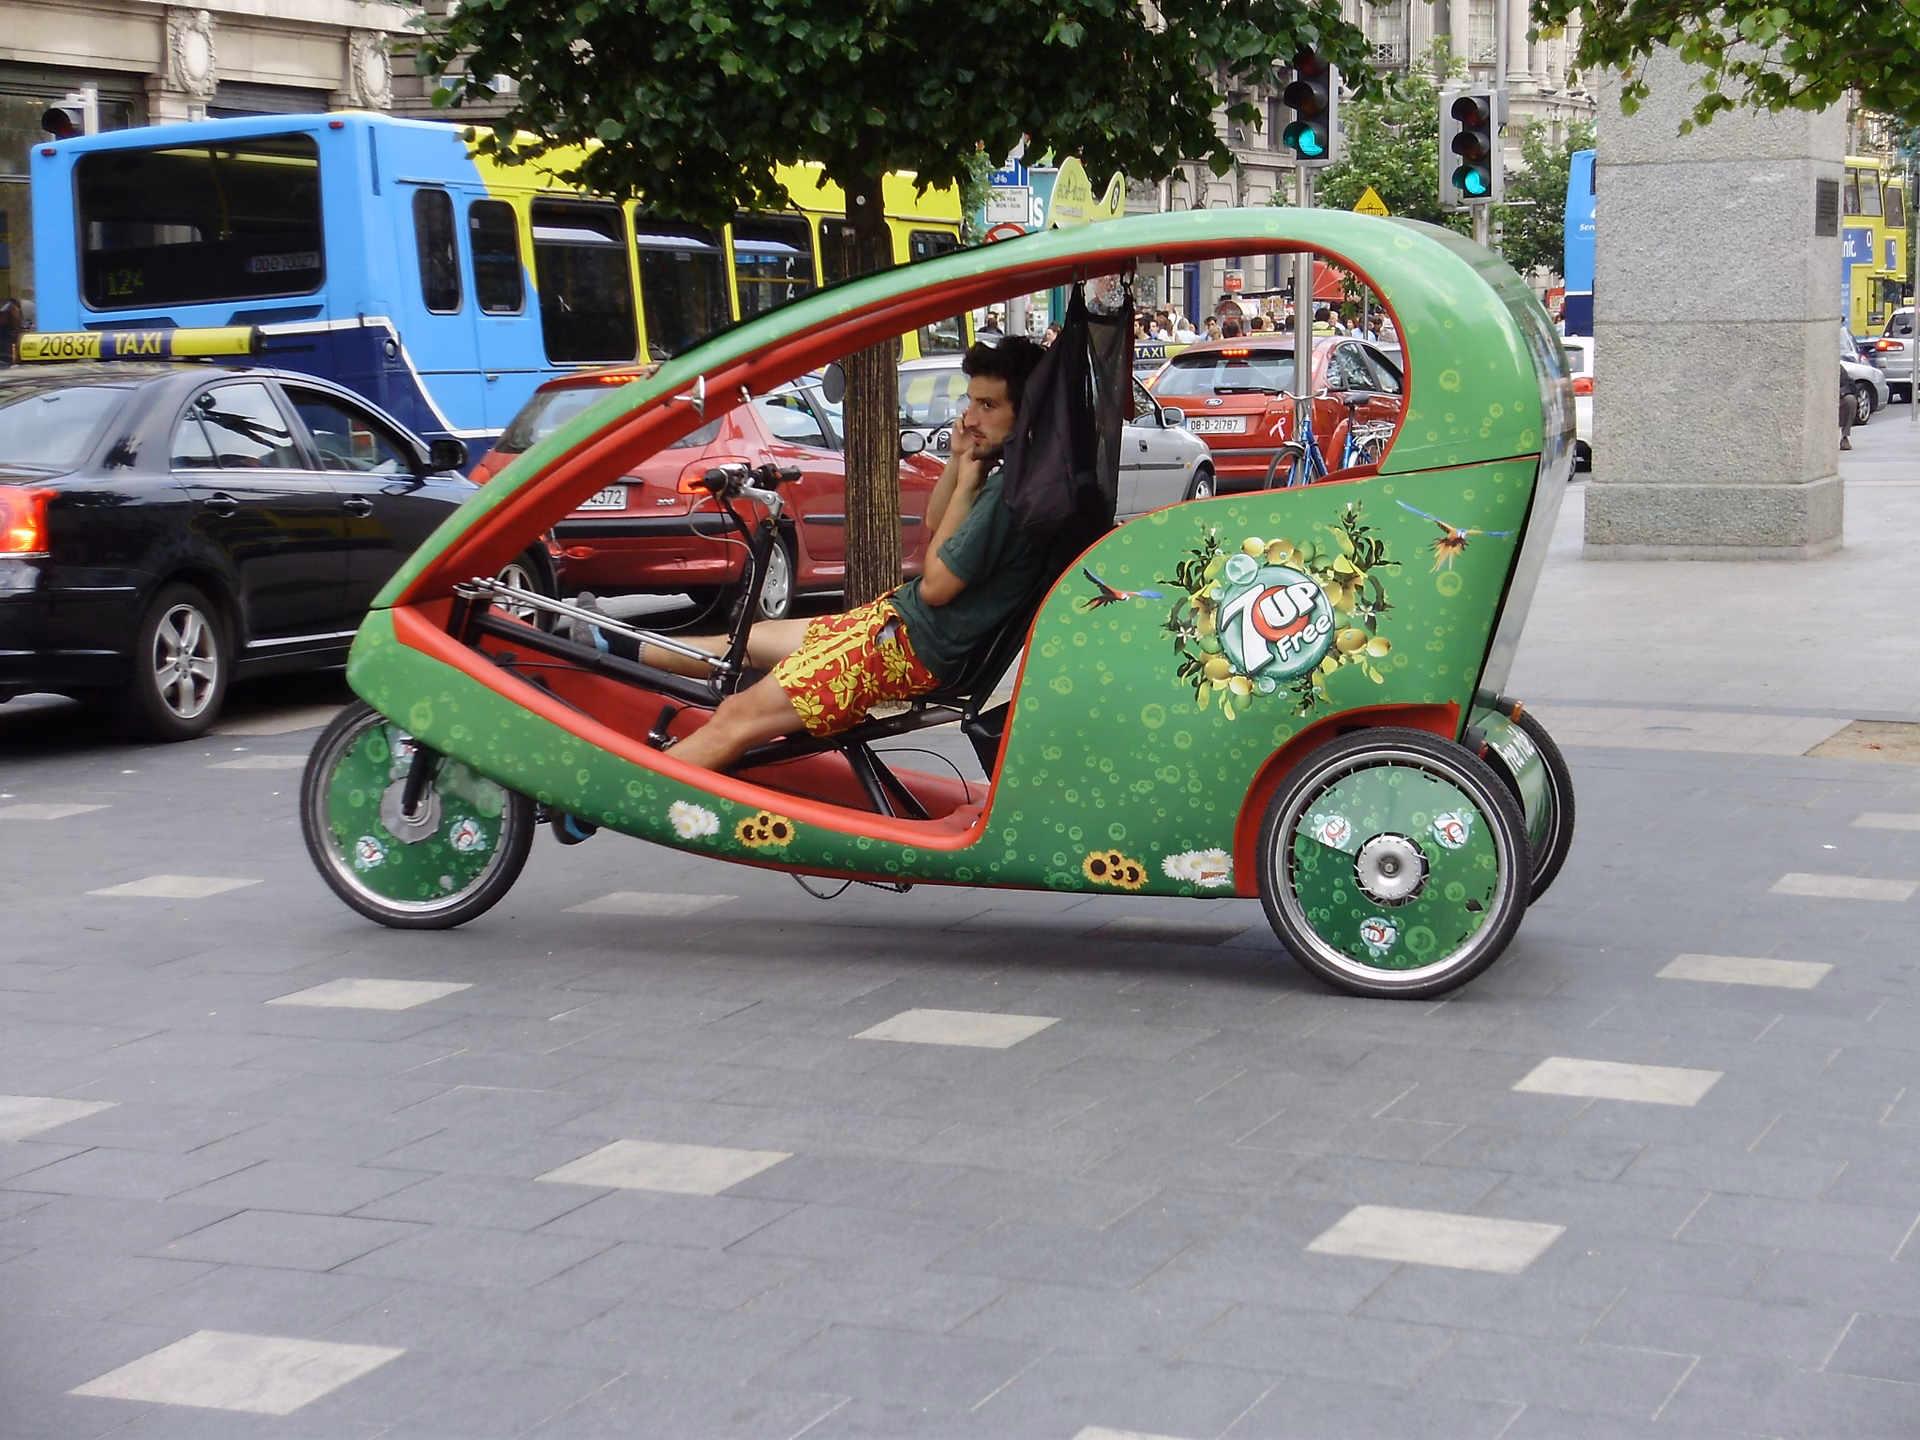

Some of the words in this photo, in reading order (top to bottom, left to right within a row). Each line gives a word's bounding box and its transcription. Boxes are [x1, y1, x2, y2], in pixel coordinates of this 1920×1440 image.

[40, 335, 97, 356] 20837
[113, 332, 162, 355] TAXI
[1135, 347, 1164, 360] TAXI
[1276, 614, 1332, 662] Free
